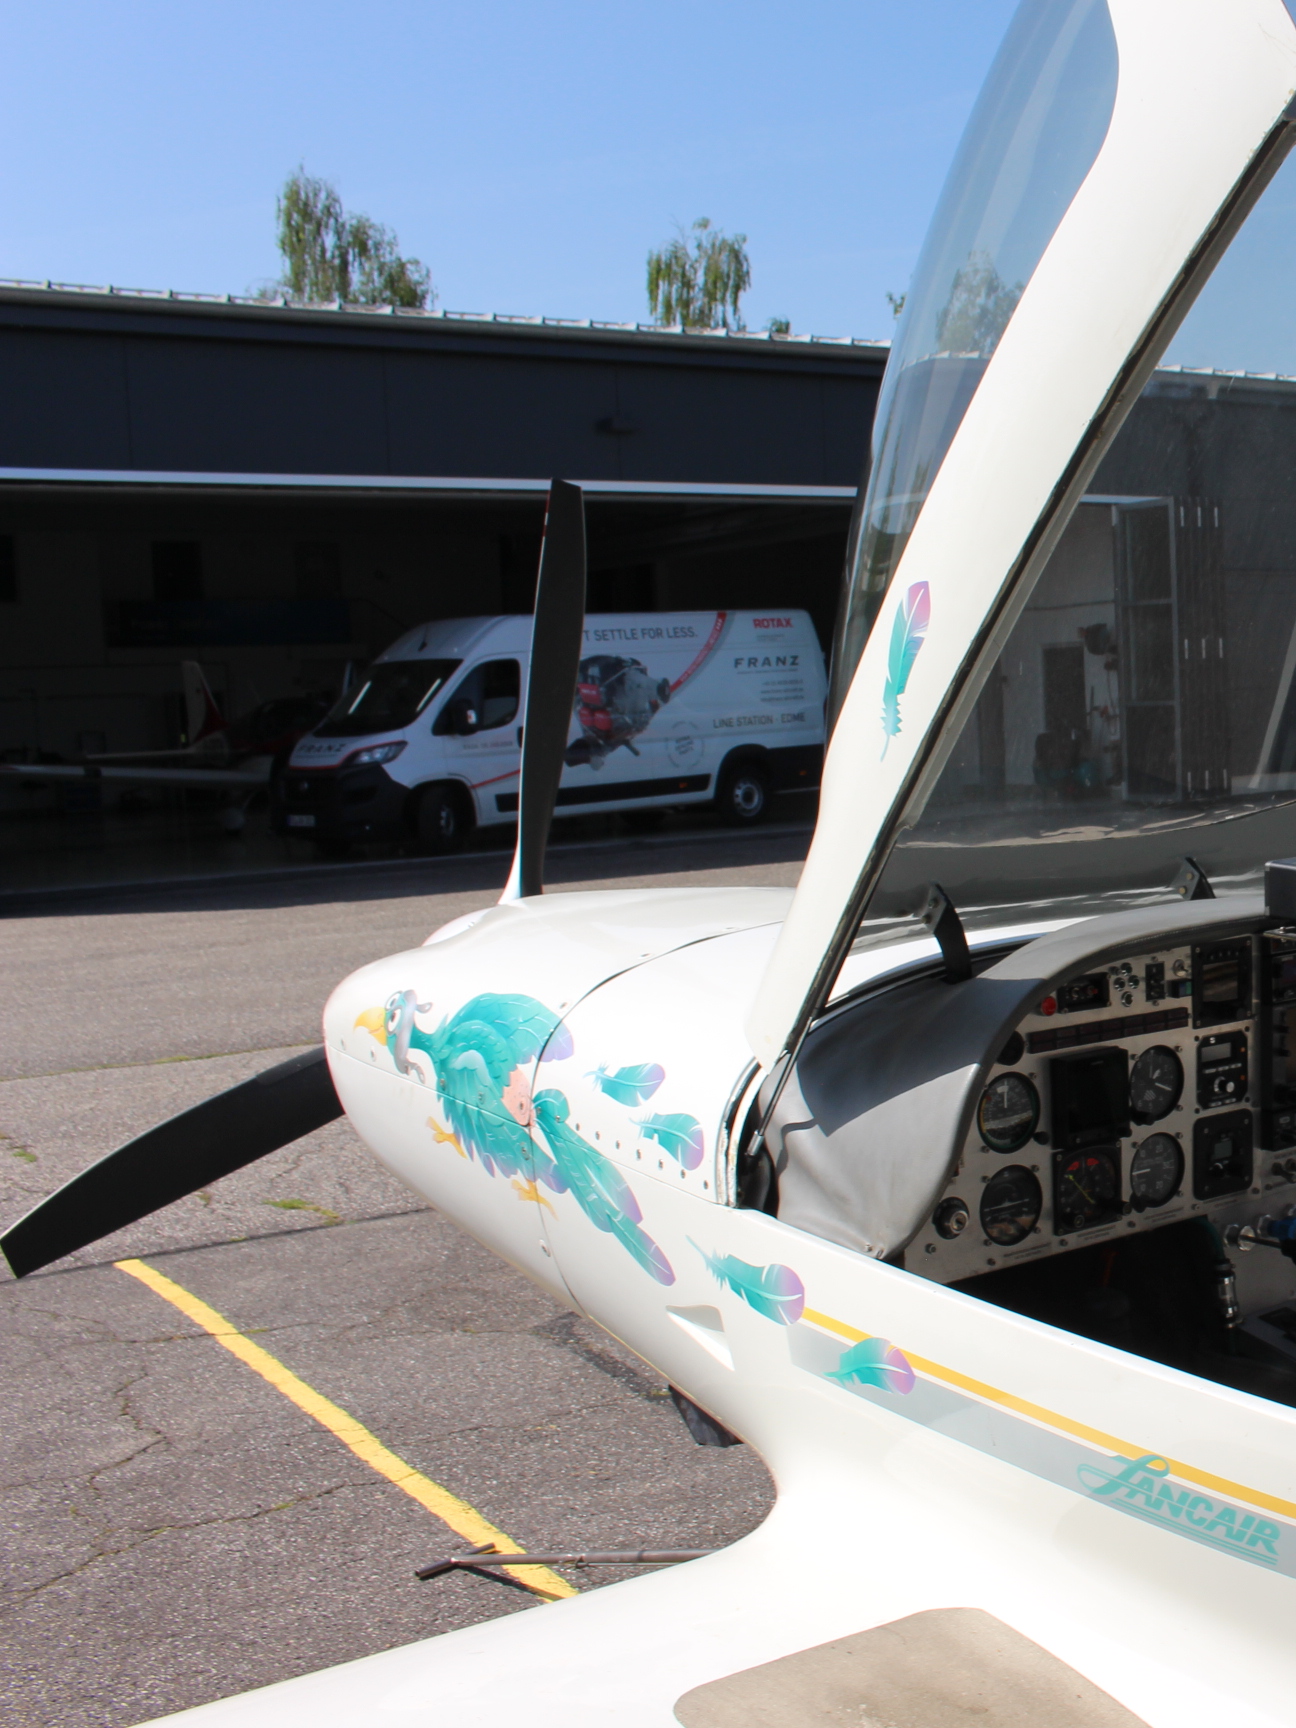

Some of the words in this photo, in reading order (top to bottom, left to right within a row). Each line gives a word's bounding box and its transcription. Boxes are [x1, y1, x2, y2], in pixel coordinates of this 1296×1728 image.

[752, 617, 794, 630] ROTAX
[594, 628, 638, 642] SETTLE
[641, 627, 665, 640] FOR
[667, 626, 698, 639] LESS.
[734, 655, 800, 669] FRANZ
[712, 717, 734, 729] LINE
[736, 715, 773, 728] STATION
[298, 743, 347, 754] FRANZ
[1077, 1454, 1280, 1556] LANCAIR
